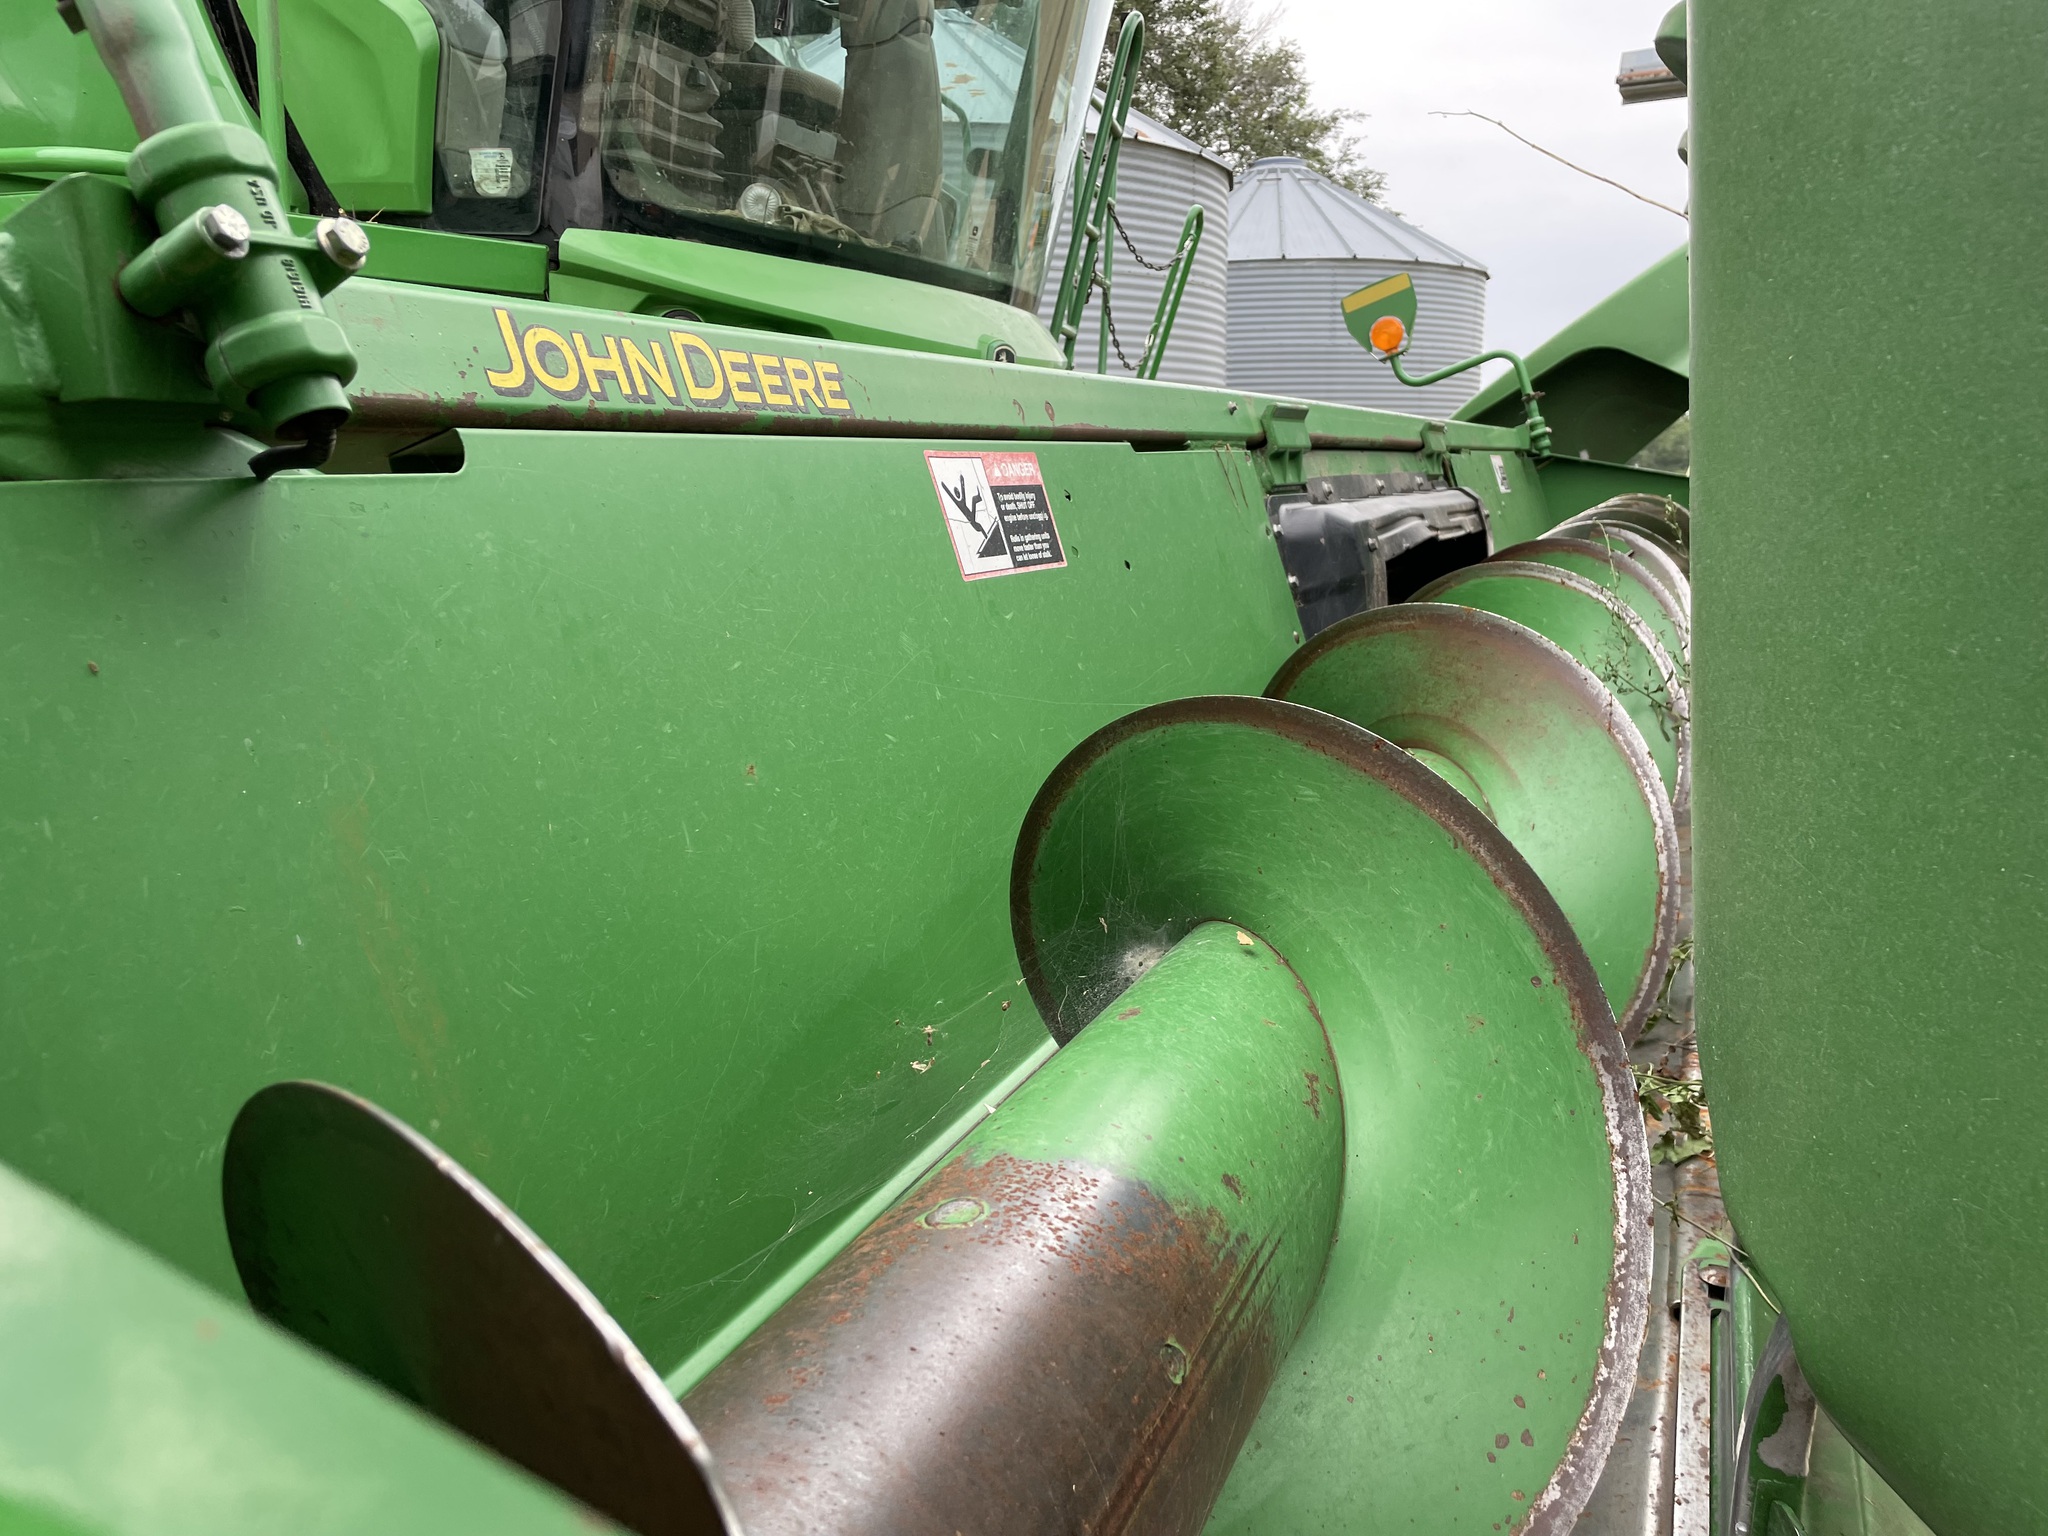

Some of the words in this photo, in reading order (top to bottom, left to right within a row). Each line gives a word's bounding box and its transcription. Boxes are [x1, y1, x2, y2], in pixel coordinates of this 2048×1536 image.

[247, 179, 268, 207] USA
[485, 308, 682, 403] JOHN
[668, 330, 853, 413] DEERE
[1000, 462, 1035, 476] DANGER
[1003, 492, 1014, 501] avoid
[1013, 492, 1026, 501] bodily
[1025, 491, 1036, 501] injury
[1016, 501, 1028, 510] SHUT
[1027, 501, 1036, 509] OFF
[1004, 513, 1017, 523] engine
[1016, 512, 1029, 521] before
[1024, 532, 1042, 543] gathering
[1023, 543, 1035, 551] faster
[1033, 542, 1043, 550] than
[1042, 542, 1050, 551] you
[1028, 552, 1039, 560] loose
